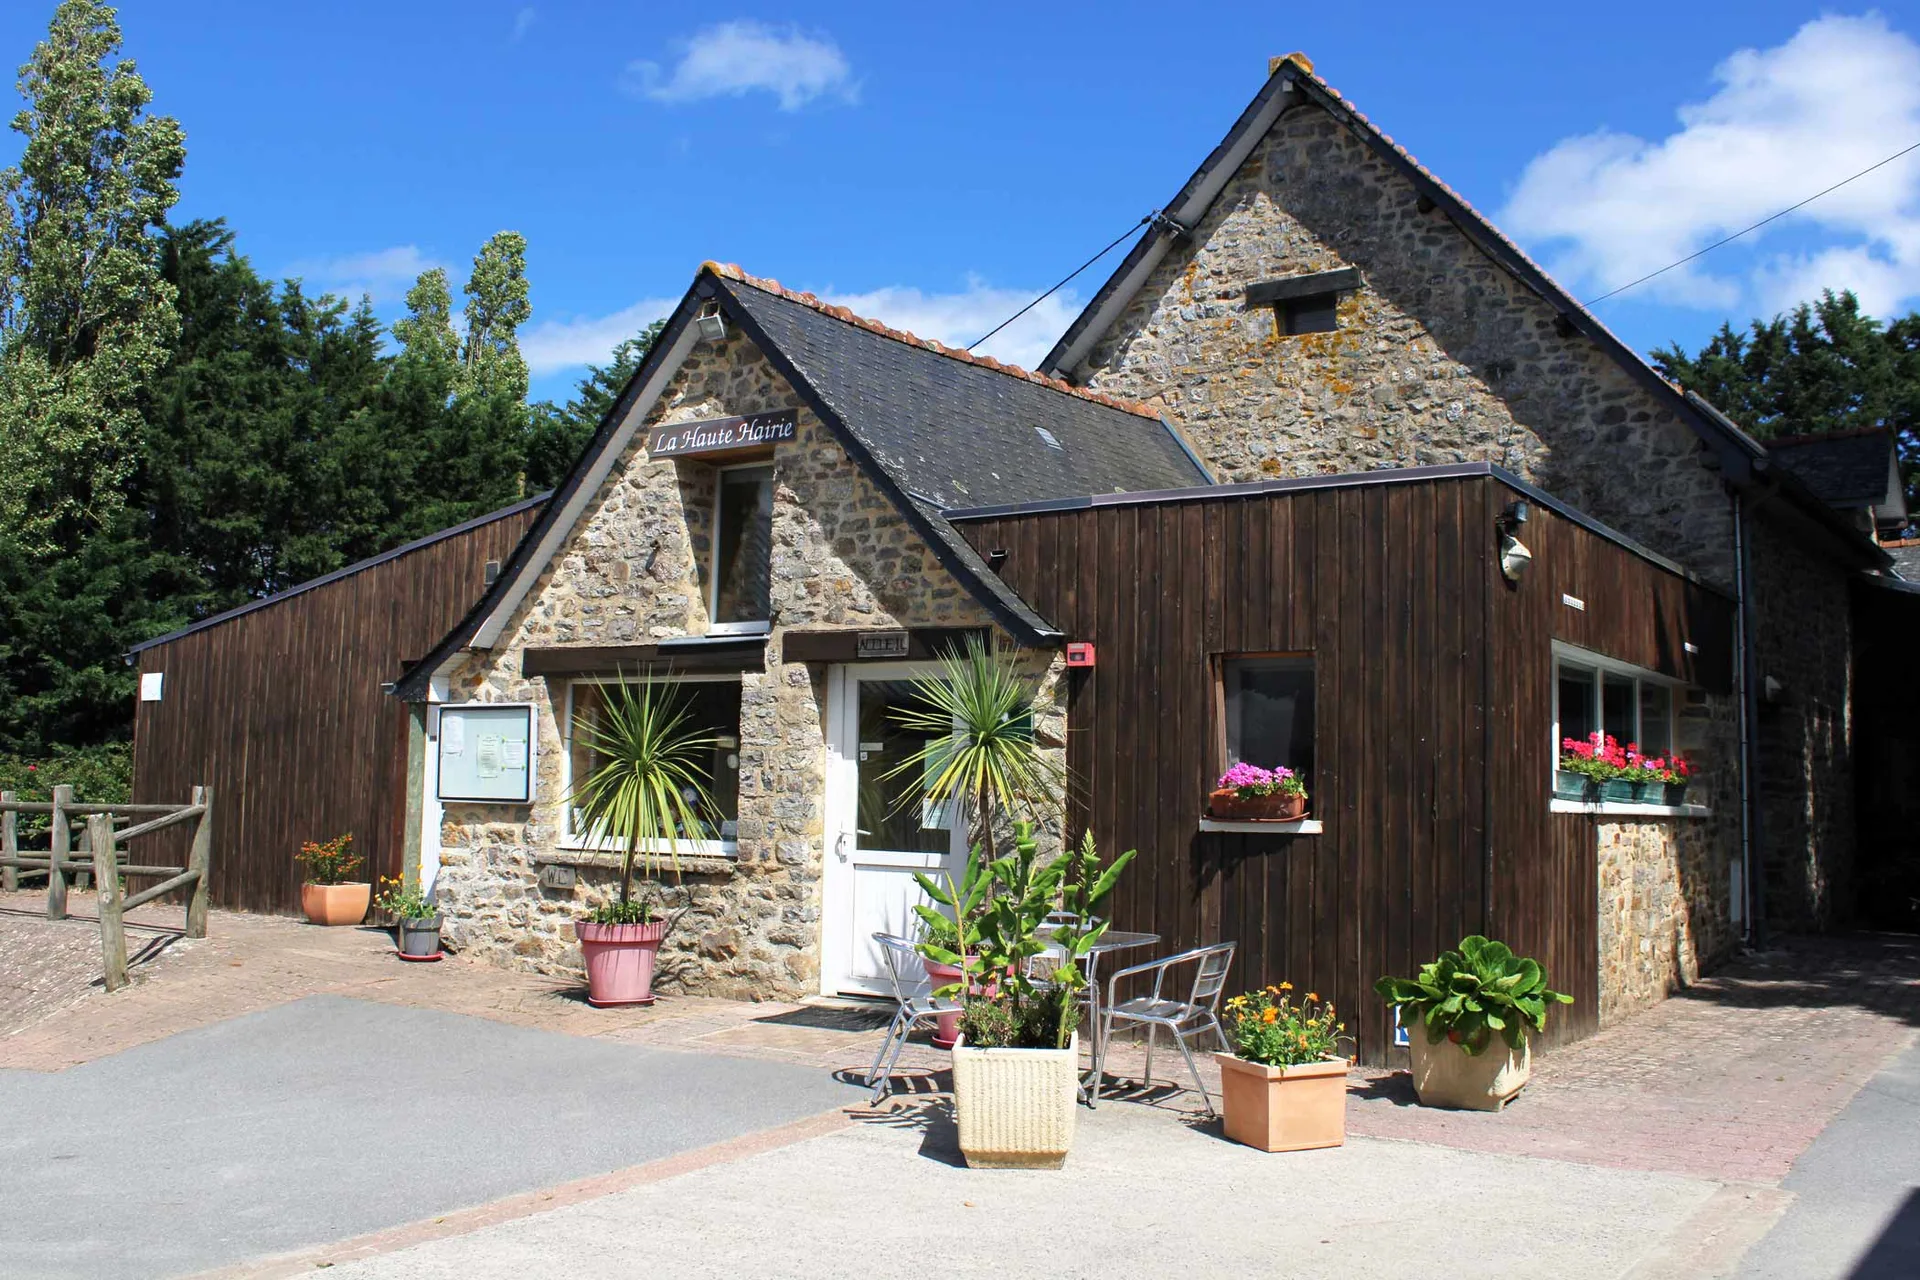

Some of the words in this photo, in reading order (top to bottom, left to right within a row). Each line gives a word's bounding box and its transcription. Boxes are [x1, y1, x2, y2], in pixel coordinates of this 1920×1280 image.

[653, 433, 677, 453] La
[680, 426, 733, 449] Haute
[736, 418, 793, 442] Hairie
